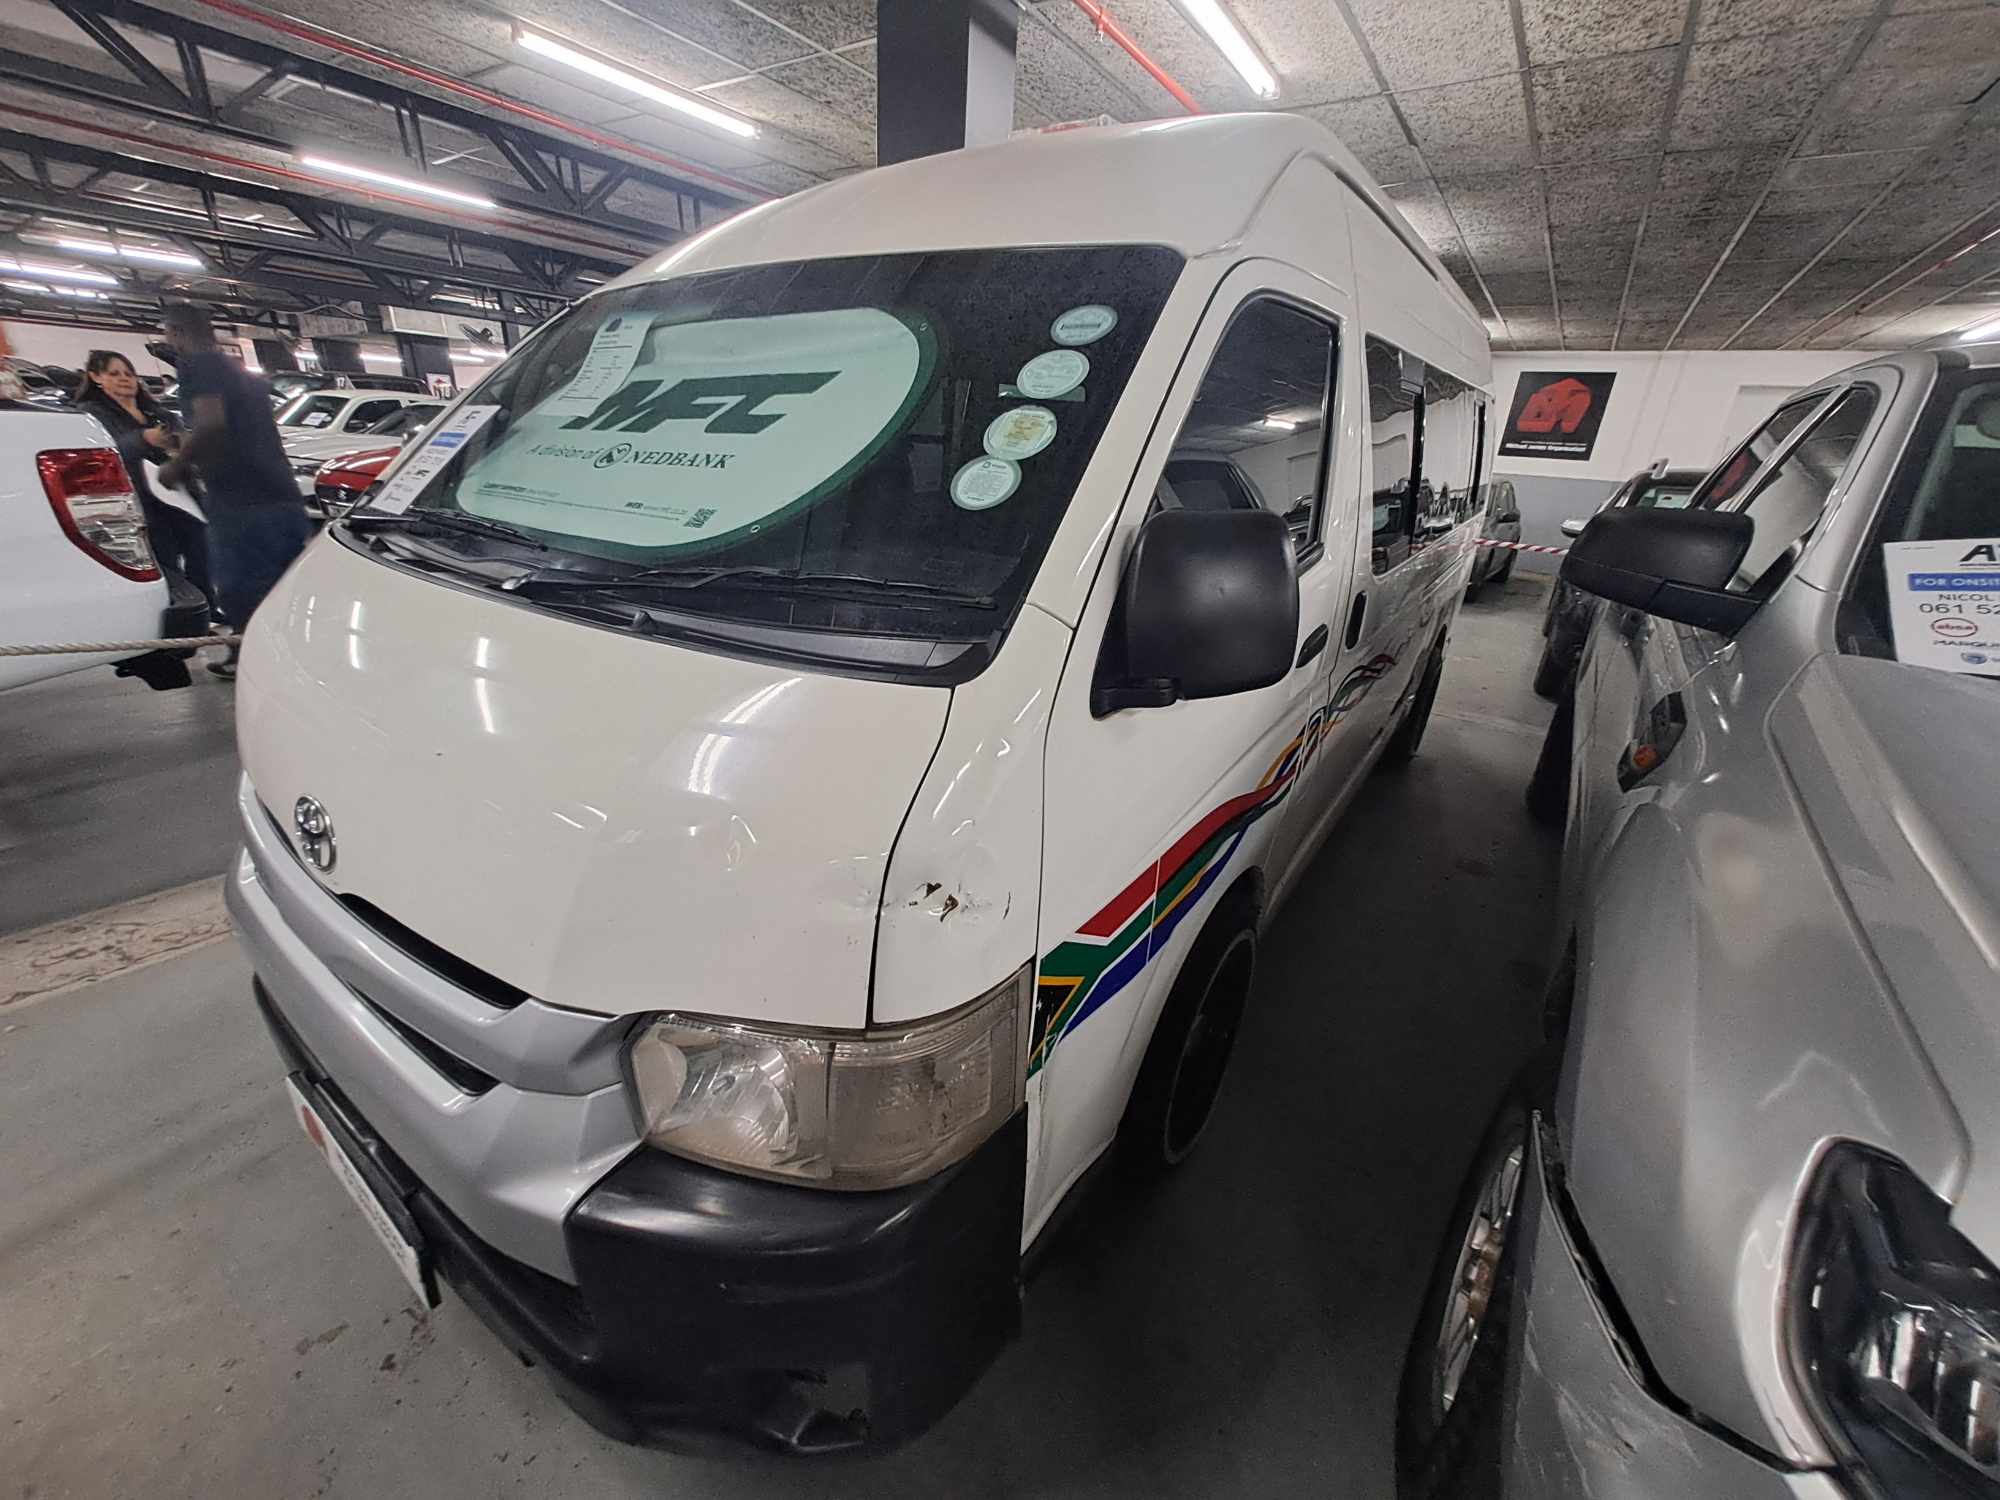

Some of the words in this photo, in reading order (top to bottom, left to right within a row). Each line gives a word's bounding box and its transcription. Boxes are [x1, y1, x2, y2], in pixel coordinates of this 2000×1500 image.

[558, 370, 843, 434] MFC
[624, 451, 736, 469] NEDBANK
[1915, 578, 1947, 587] FOR
[1939, 593, 1995, 602] NICOL
[1920, 603, 1963, 614] 061
